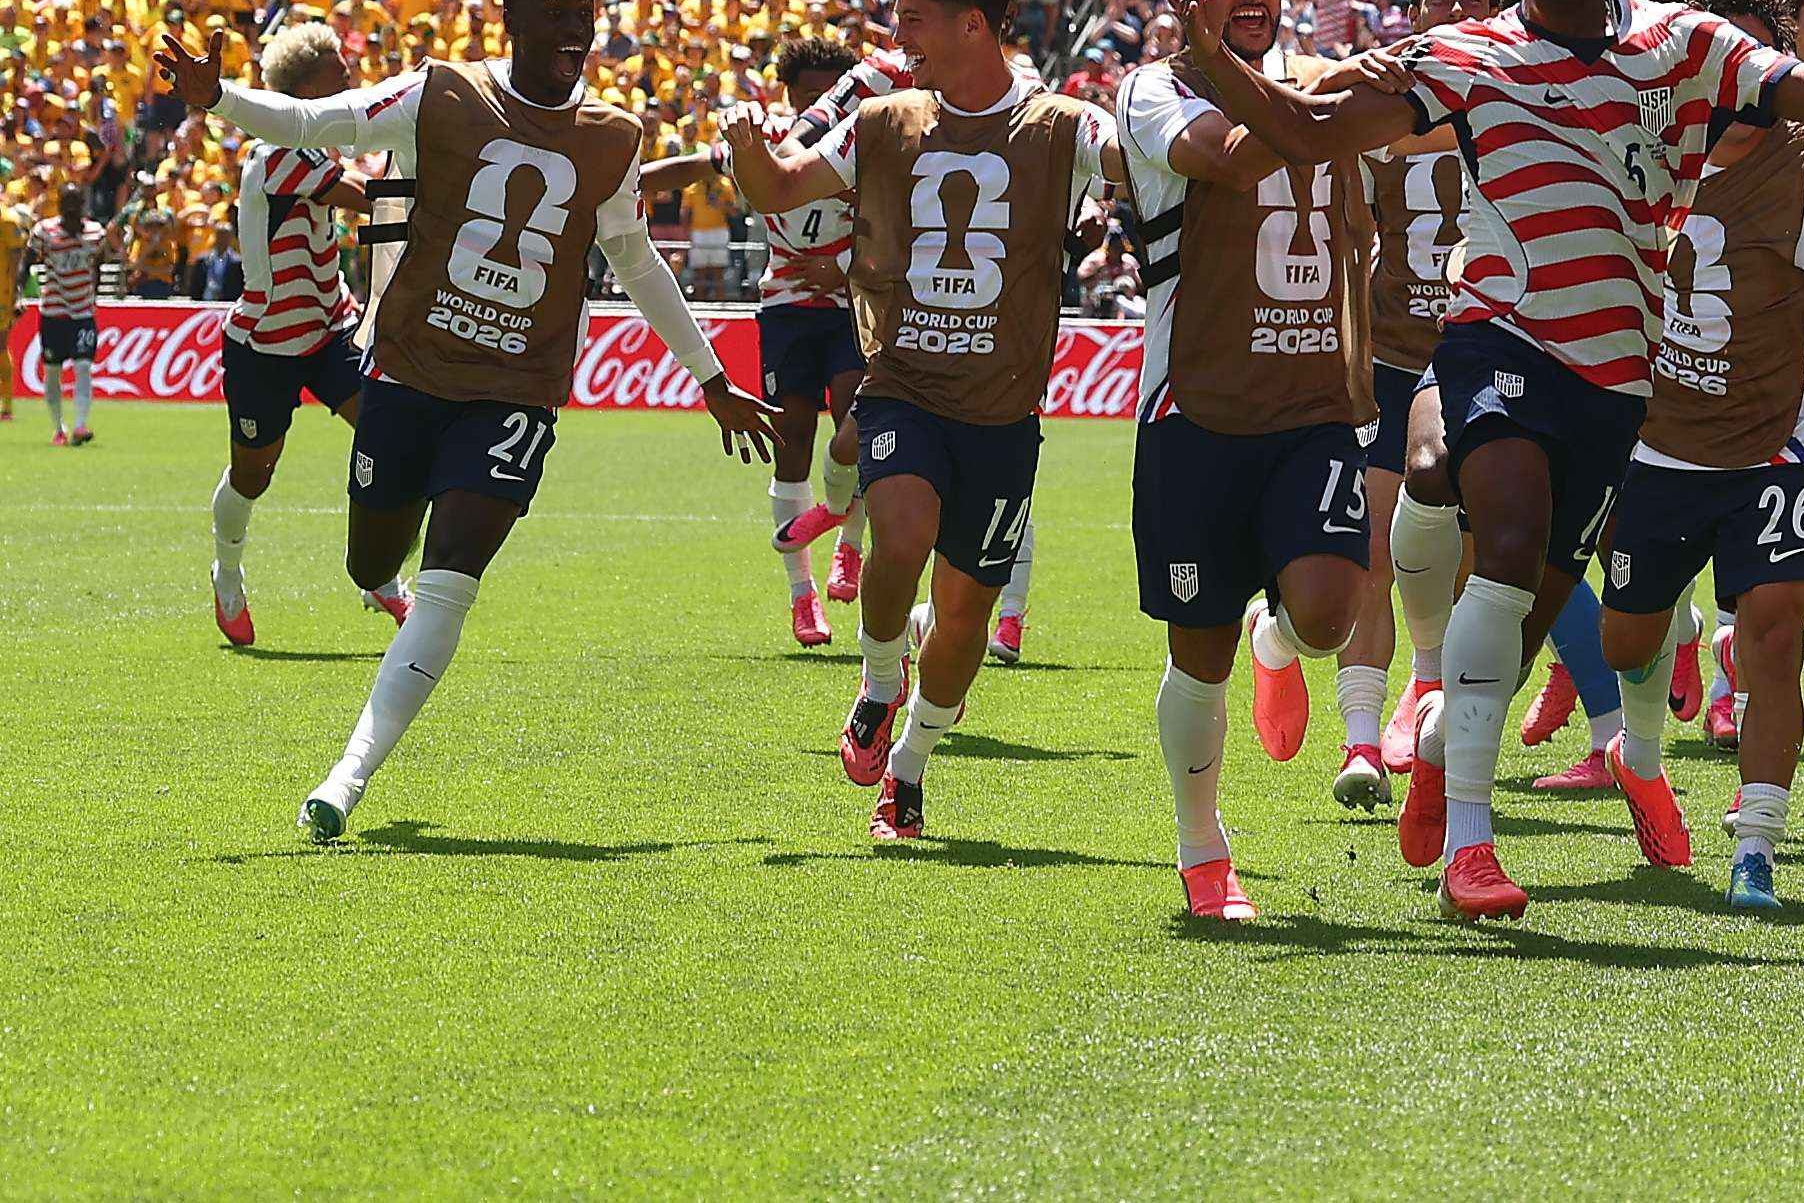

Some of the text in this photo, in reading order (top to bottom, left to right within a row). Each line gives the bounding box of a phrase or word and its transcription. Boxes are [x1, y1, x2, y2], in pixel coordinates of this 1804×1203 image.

[1640, 87, 1670, 108] USA
[801, 209, 823, 244] 4
[473, 265, 519, 293] FIFA
[932, 276, 976, 295] FIFA
[1286, 265, 1320, 284] FIFA
[1407, 284, 1450, 297] WOR
[436, 289, 532, 331] WORLD CUP
[902, 308, 998, 331] WORLD CUP
[1253, 307, 1334, 324] WORLD CUP
[1408, 298, 1451, 317] 20
[78, 328, 95, 349] 20
[426, 306, 528, 355] 2026
[895, 327, 994, 354] 2026
[1250, 327, 1339, 354] 2026
[1658, 342, 1731, 374] ORLD CUP
[1495, 370, 1524, 387] USA
[1654, 356, 1728, 396] 026
[487, 411, 547, 470] 21
[872, 431, 895, 447] USA
[1318, 459, 1366, 520] 15
[982, 496, 1030, 550] 14
[1170, 564, 1197, 580] USA
